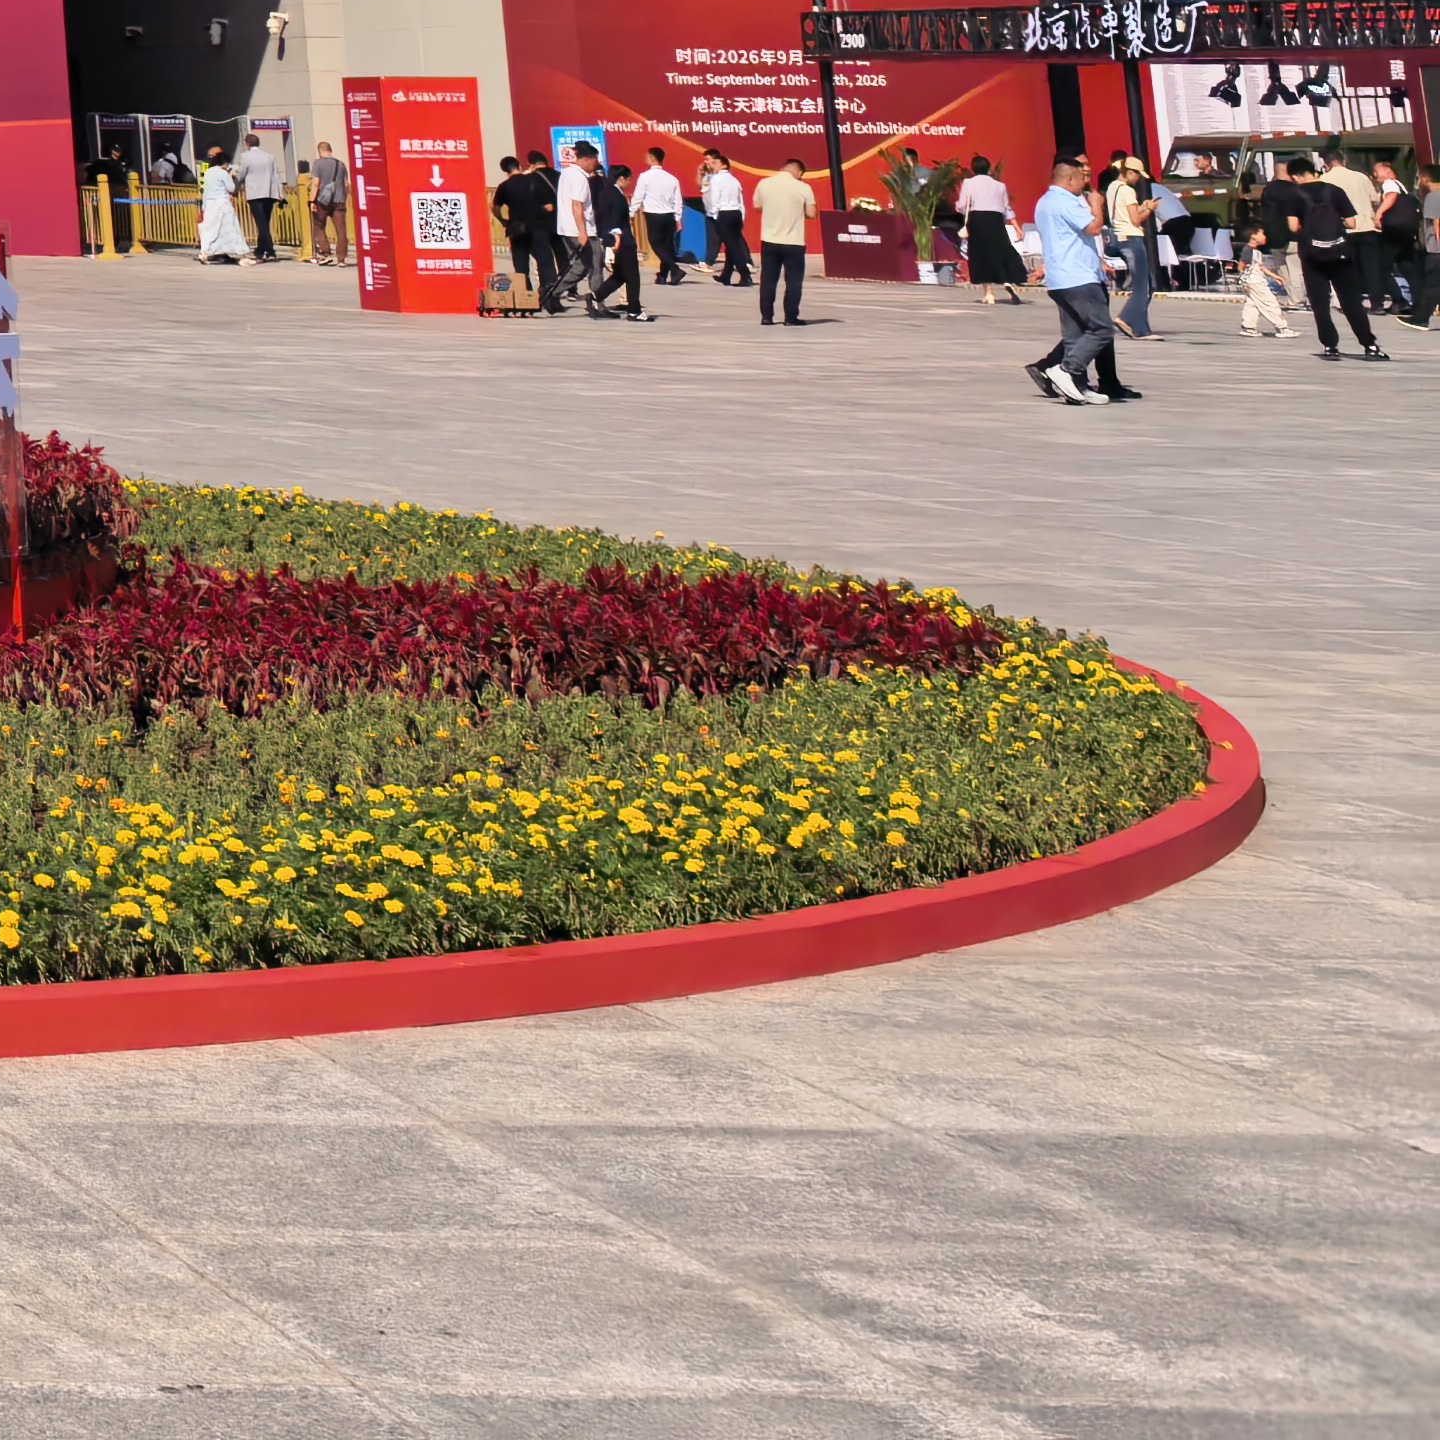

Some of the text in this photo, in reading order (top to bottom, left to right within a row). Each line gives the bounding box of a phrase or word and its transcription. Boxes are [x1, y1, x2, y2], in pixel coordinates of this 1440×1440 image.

[666, 73, 703, 84] Time:
[706, 73, 777, 87] September
[856, 74, 886, 86] 2026
[645, 120, 690, 134] Tianjin
[691, 120, 747, 136] Meijiang
[749, 121, 824, 135] Convention
[854, 122, 919, 136] Exhibition
[921, 123, 966, 137] Center
